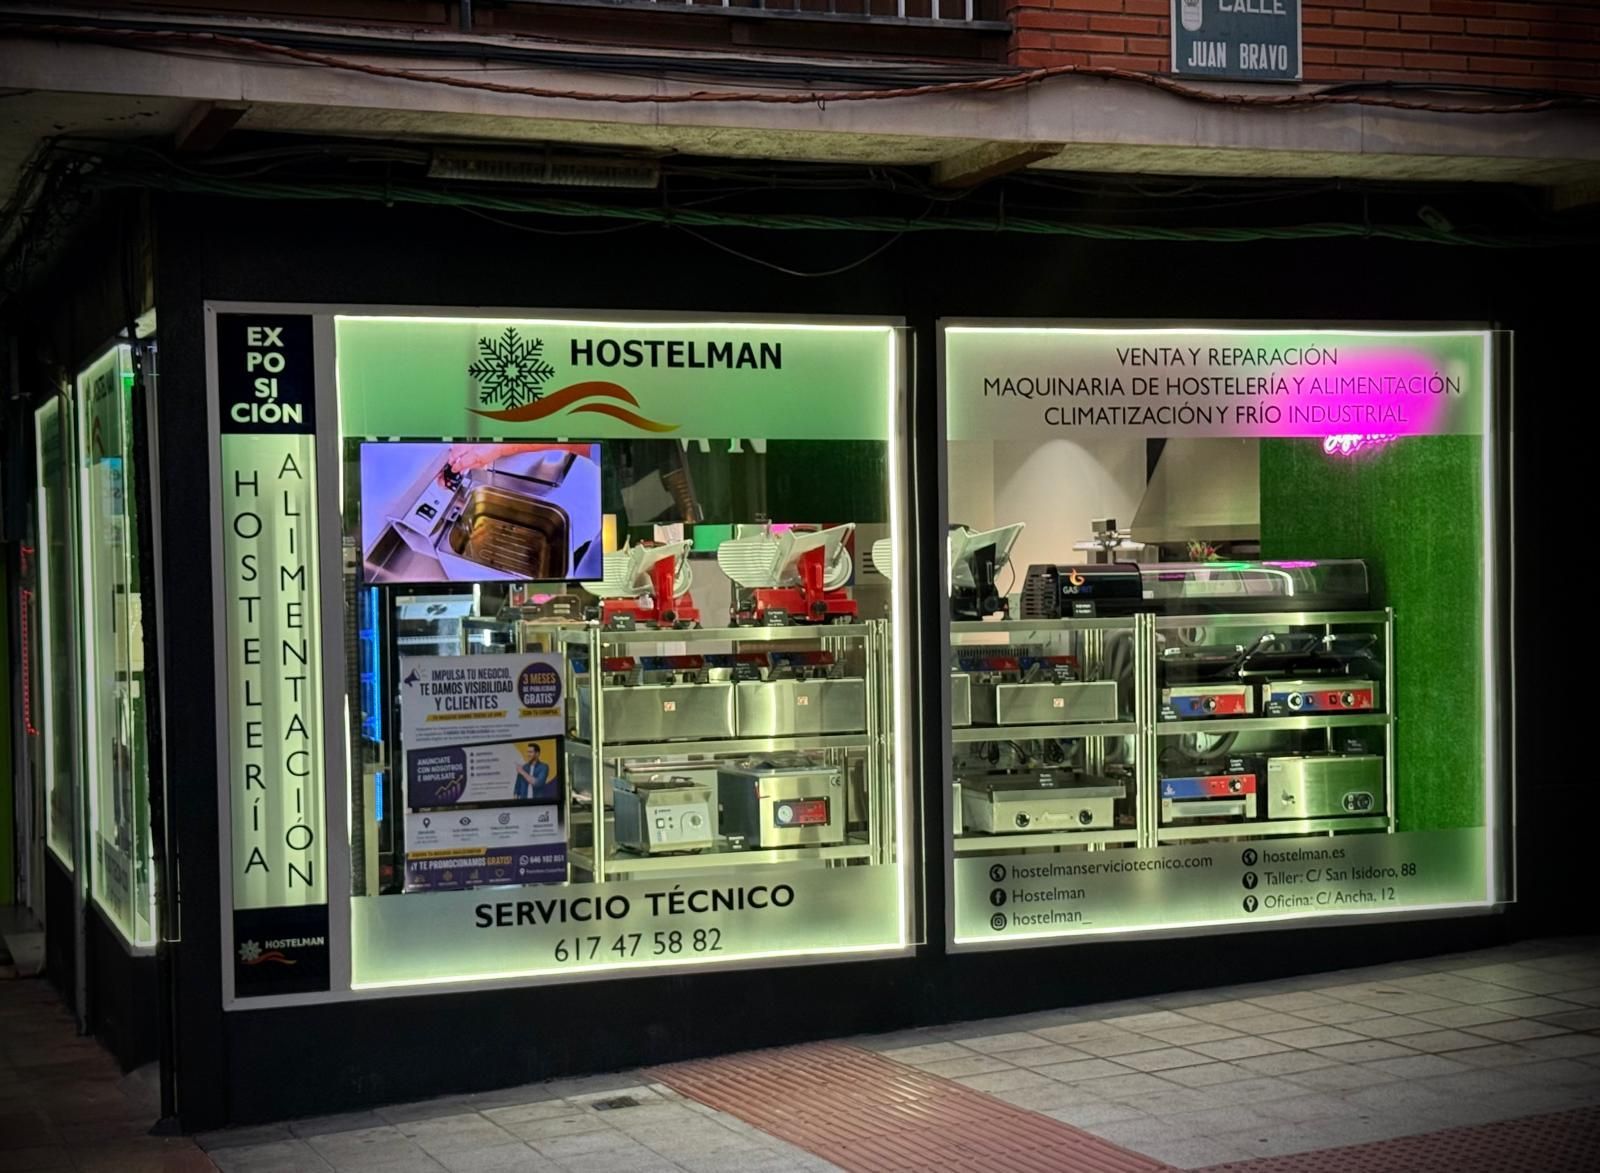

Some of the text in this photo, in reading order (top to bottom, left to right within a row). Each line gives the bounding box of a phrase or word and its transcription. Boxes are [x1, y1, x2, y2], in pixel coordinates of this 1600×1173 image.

[1219, 0, 1287, 15] CALLE
[1188, 41, 1288, 71] JUAN BRAVO
[247, 326, 284, 347] EX
[247, 352, 286, 373] PO
[570, 338, 783, 370] HOSTELMAN
[1116, 343, 1338, 367] VENTA Y REPARACIÓN
[254, 377, 278, 398] SI
[983, 371, 1461, 399] MAQUINARIA DE HOSTELERÍA Y ALIMENTACIÓN
[230, 397, 303, 424] CIÓN
[1044, 400, 1408, 426] CLIMATIZACIÓN Y FRÍO INDUSTRIAL
[234, 469, 271, 875] HOSTELERÍA
[277, 452, 315, 889] ALIMENTACIÓN
[431, 670, 466, 682] IMPULSA
[468, 669, 477, 681] TU
[523, 672, 557, 685] 3 MESES
[420, 680, 514, 696] TE DAMOS VISIBILIDAD
[435, 696, 499, 712] Y CLIENTES
[417, 763, 464, 774] CON NOSOTROS
[419, 860, 428, 870] TE
[429, 857, 486, 869] PROMOCIONAMOS
[1263, 847, 1346, 863] hostelman.es
[1012, 856, 1213, 880] hostelmanserviciotecnico.com
[1264, 862, 1417, 886] Taller: C/ San Isidoro, 88
[1012, 887, 1085, 903] Hostelman
[1264, 887, 1395, 909] Oficina: C/ Ancha, 12
[475, 884, 795, 929] SERVICIO TÉCNICO
[265, 936, 325, 949] HOSTELMAN
[554, 927, 723, 962] 617 47 58 82
